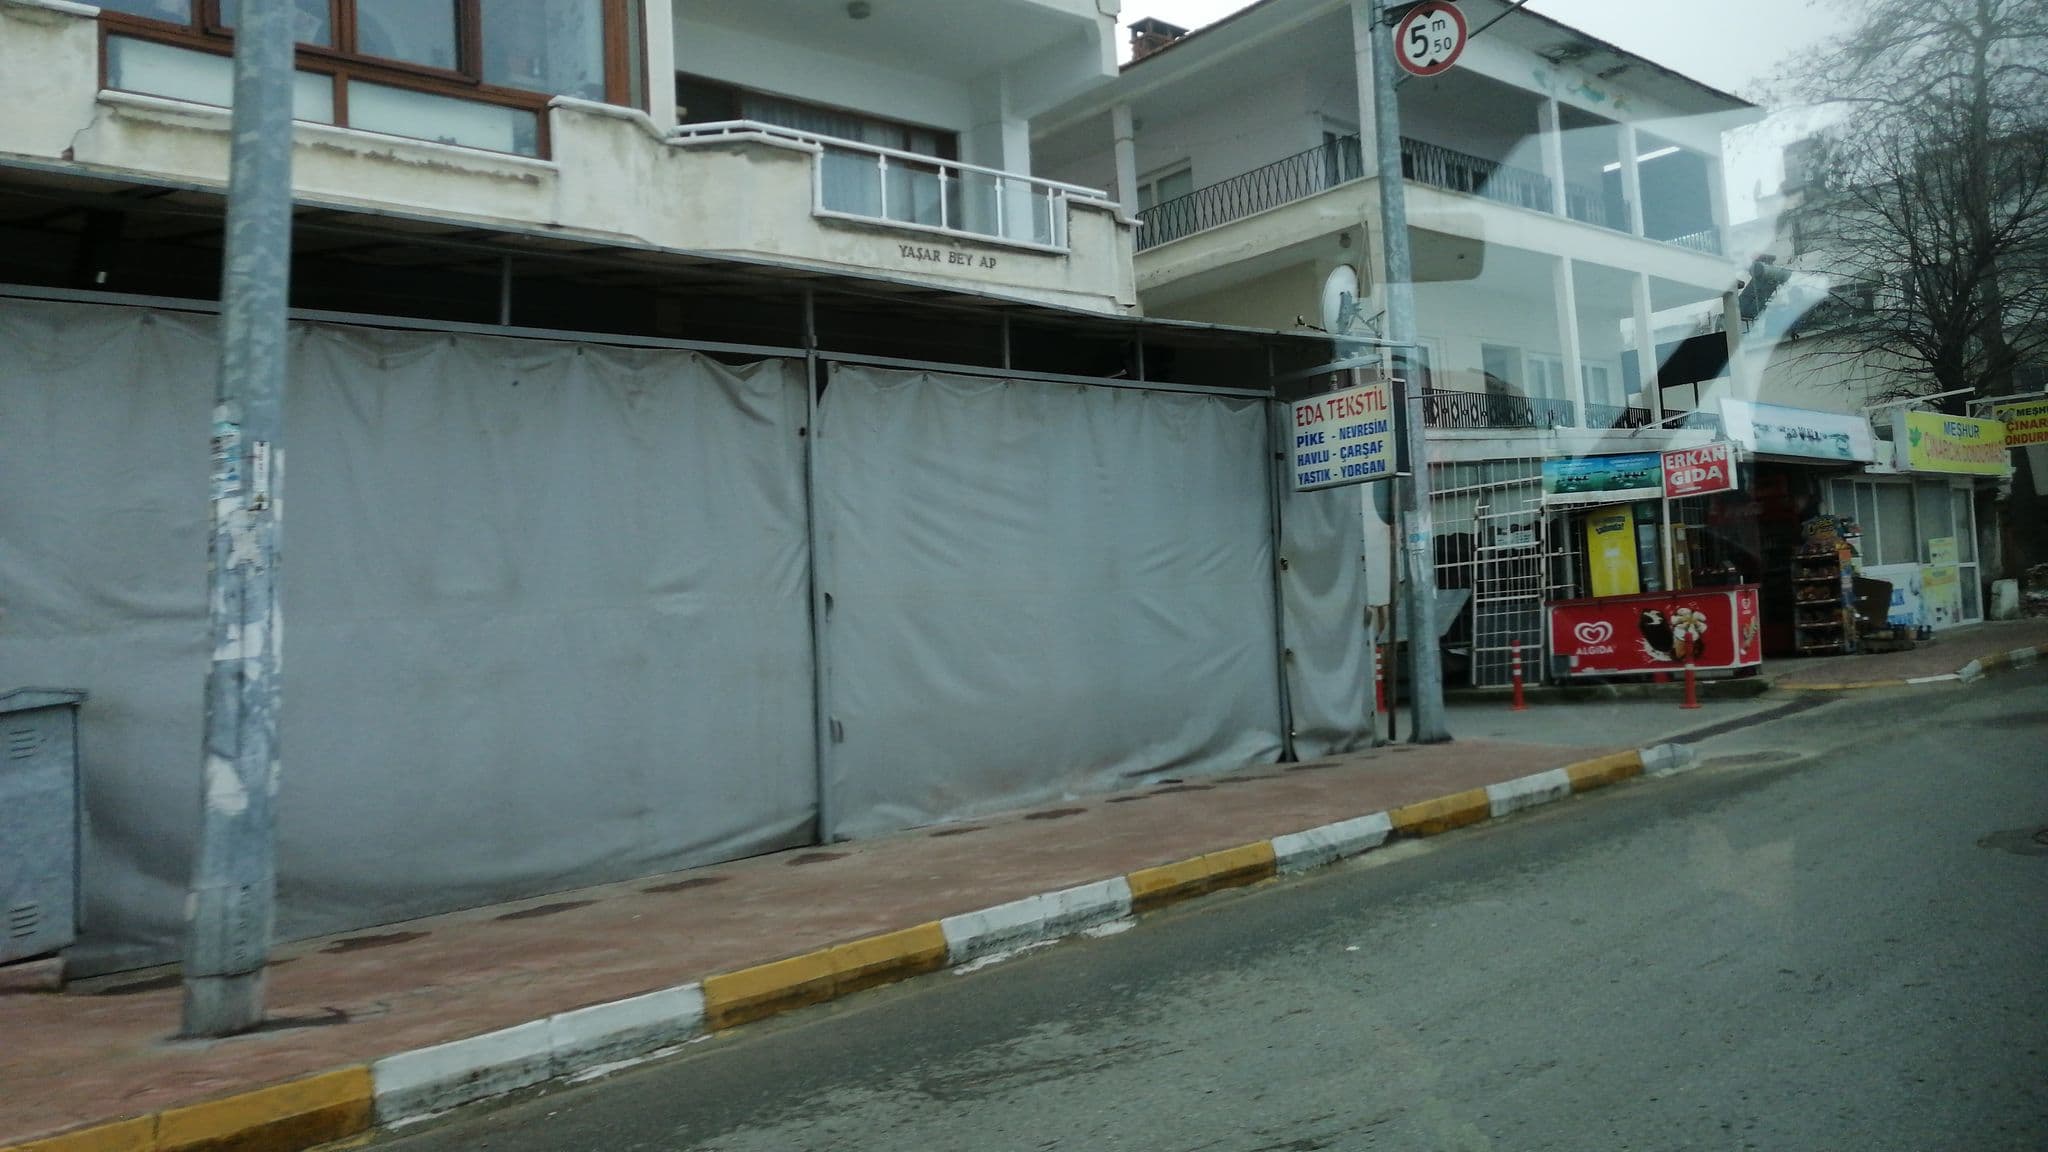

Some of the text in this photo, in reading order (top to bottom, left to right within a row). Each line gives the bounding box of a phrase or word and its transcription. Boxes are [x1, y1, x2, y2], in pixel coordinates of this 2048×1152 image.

[1411, 19, 1446, 58] 5 m
[899, 244, 997, 269] YAŞAR BEY AP
[1296, 386, 1388, 427] EDA TEKSTİL
[2016, 404, 2048, 417] MEŞH
[1296, 431, 1325, 448] PİKE
[1339, 418, 1388, 440] NEVRESİM
[1943, 421, 1980, 440] MEŞHUR
[1297, 450, 1329, 467] HAVLU
[1340, 440, 1384, 462] ÇARŞAF
[1665, 445, 1727, 470] ERKAN
[1298, 469, 1331, 485] YASTIK
[1340, 459, 1386, 478] YORGAN
[1670, 465, 1723, 485] GIDA
[1576, 646, 1614, 655] ALGIDA
